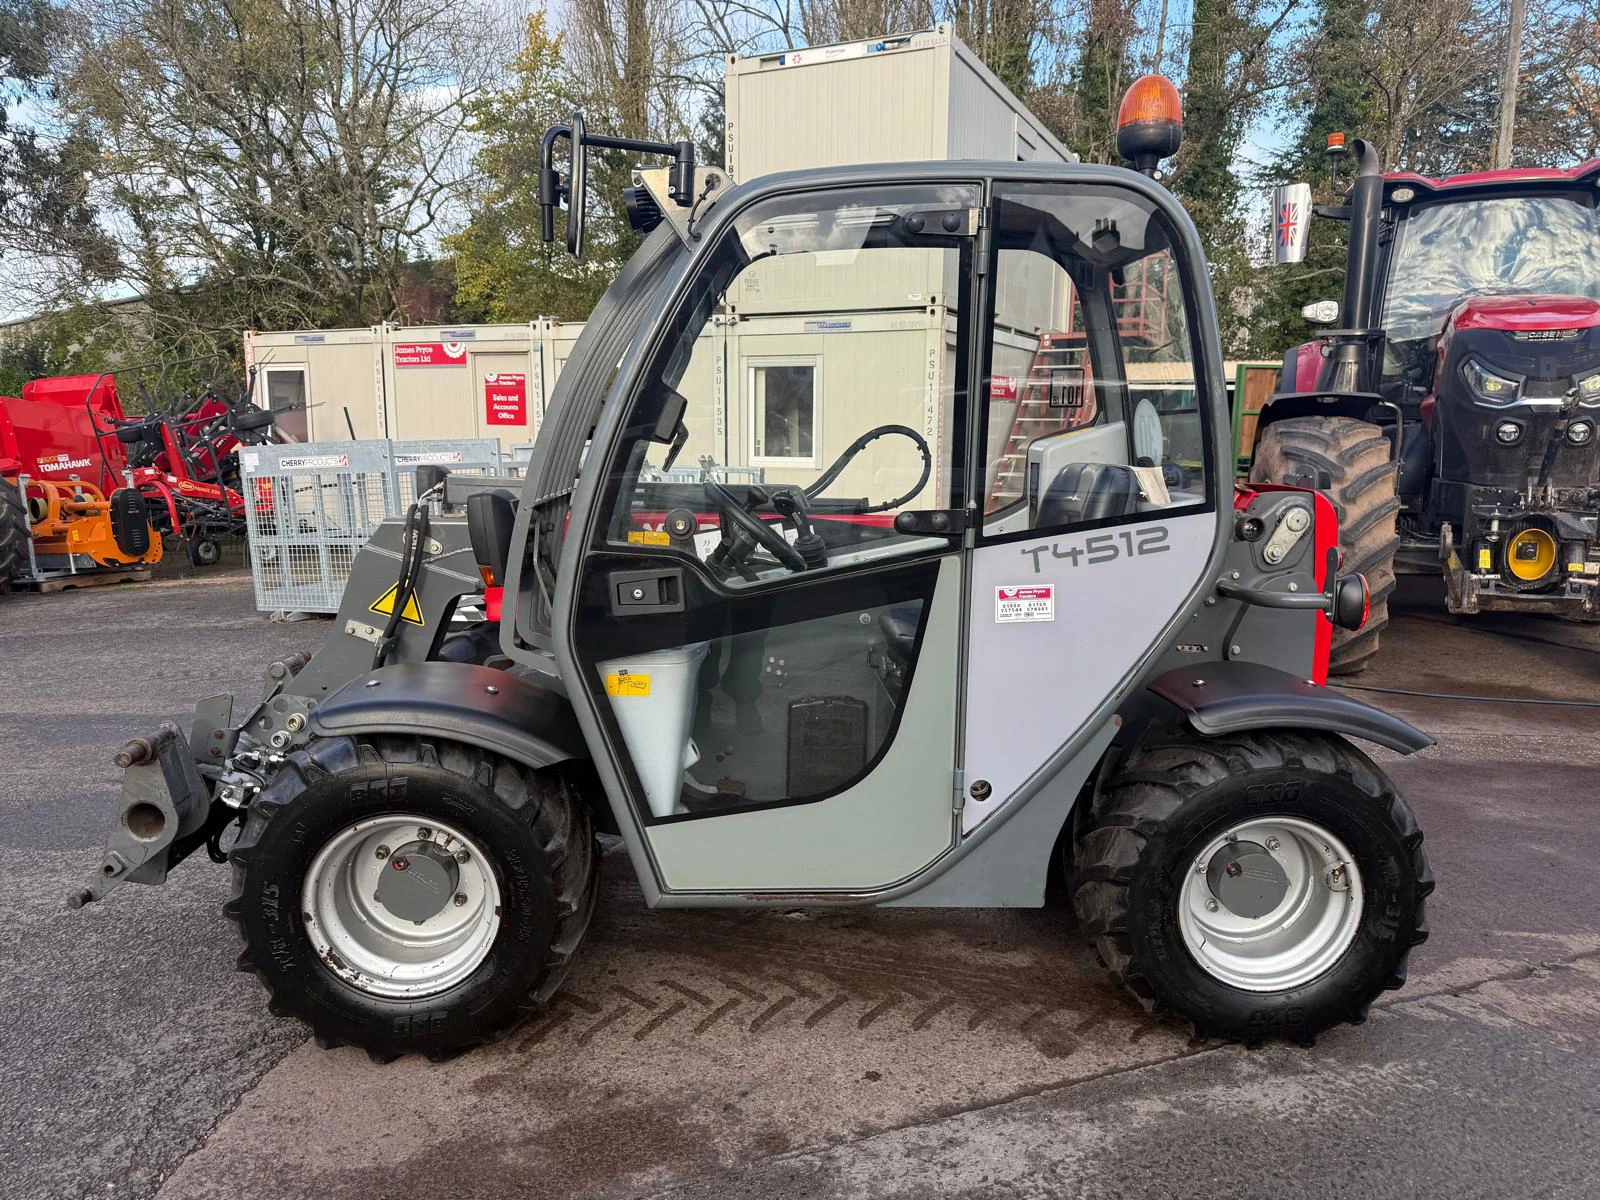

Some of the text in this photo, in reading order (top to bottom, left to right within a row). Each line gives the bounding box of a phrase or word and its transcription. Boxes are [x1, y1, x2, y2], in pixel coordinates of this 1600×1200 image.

[394, 346, 433, 354] James Pryce
[395, 355, 431, 363] Tractors Ltd
[927, 348, 936, 436] PSU11472
[492, 393, 507, 401] Sales
[492, 403, 519, 411] Accounts
[497, 411, 515, 420] Office
[38, 458, 92, 472] TOMAHAWK
[1021, 525, 1171, 573] T4512
